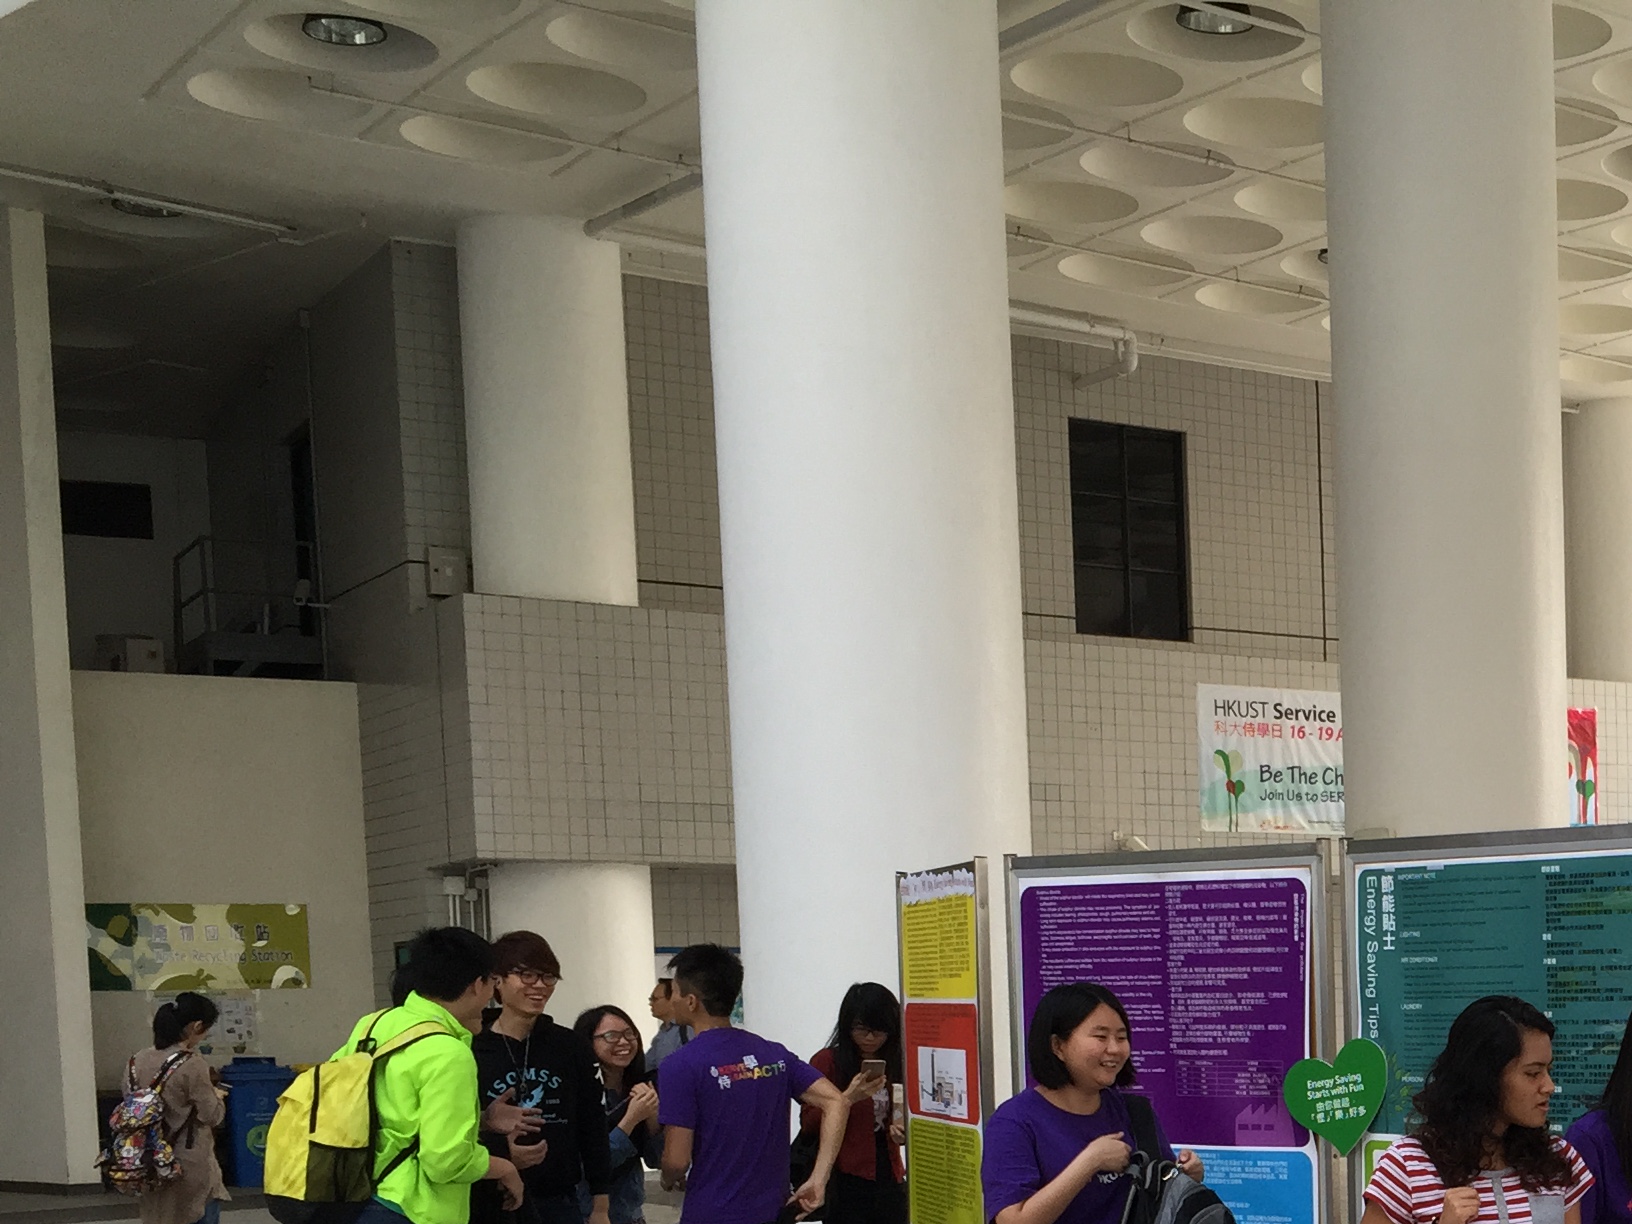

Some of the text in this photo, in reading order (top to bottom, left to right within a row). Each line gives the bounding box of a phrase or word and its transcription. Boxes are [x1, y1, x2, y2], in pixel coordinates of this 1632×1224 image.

[1213, 699, 1336, 723] HKUST Service
[1290, 725, 1306, 739] 16
[1317, 726, 1334, 741] 19
[1259, 764, 1284, 784] Be
[1286, 765, 1318, 785] The
[1259, 789, 1285, 801] Join
[1305, 791, 1318, 803] to
[192, 951, 247, 965] Recycling
[251, 950, 294, 962] Station
[1364, 876, 1380, 1039] Energy Saving Tips
[1307, 1073, 1362, 1089] Energy Saving
[1307, 1083, 1364, 1100] Starts with Fun
